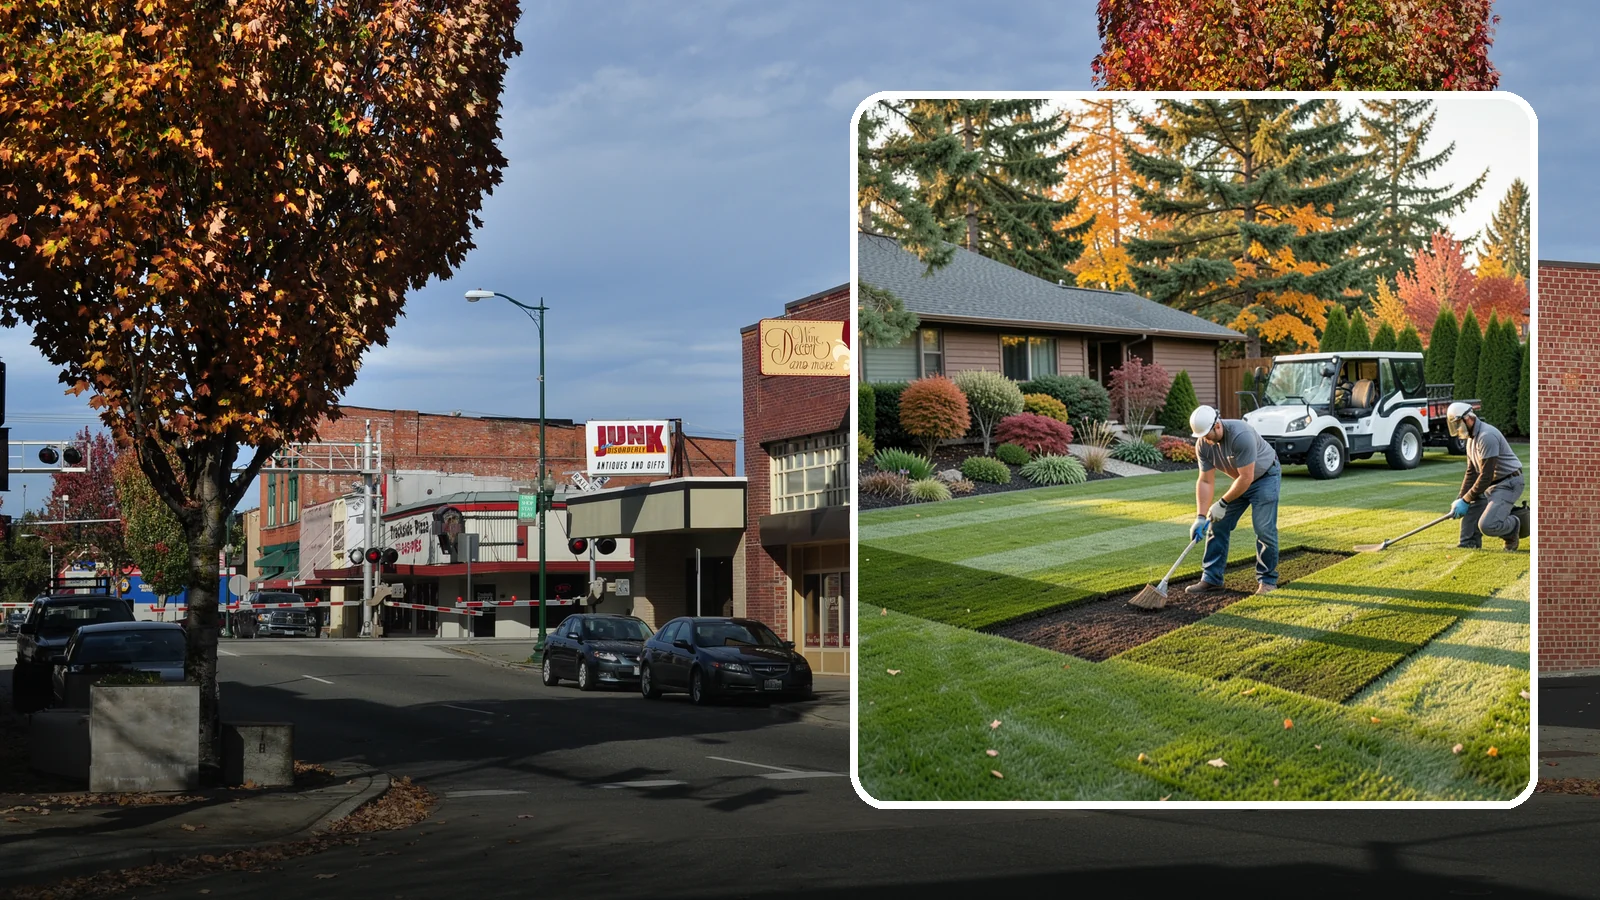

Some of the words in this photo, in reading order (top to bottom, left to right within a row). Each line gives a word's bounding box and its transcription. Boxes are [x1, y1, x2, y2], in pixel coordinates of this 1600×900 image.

[595, 425, 665, 457] JUNK
[607, 446, 646, 454] DISORDERLY
[597, 461, 628, 470] ANTIQUES
[631, 461, 644, 470] AND
[646, 460, 665, 469] GIFTS
[573, 473, 589, 492] RAIL
[390, 521, 413, 540] Trackside
[414, 519, 429, 535] Pizza
